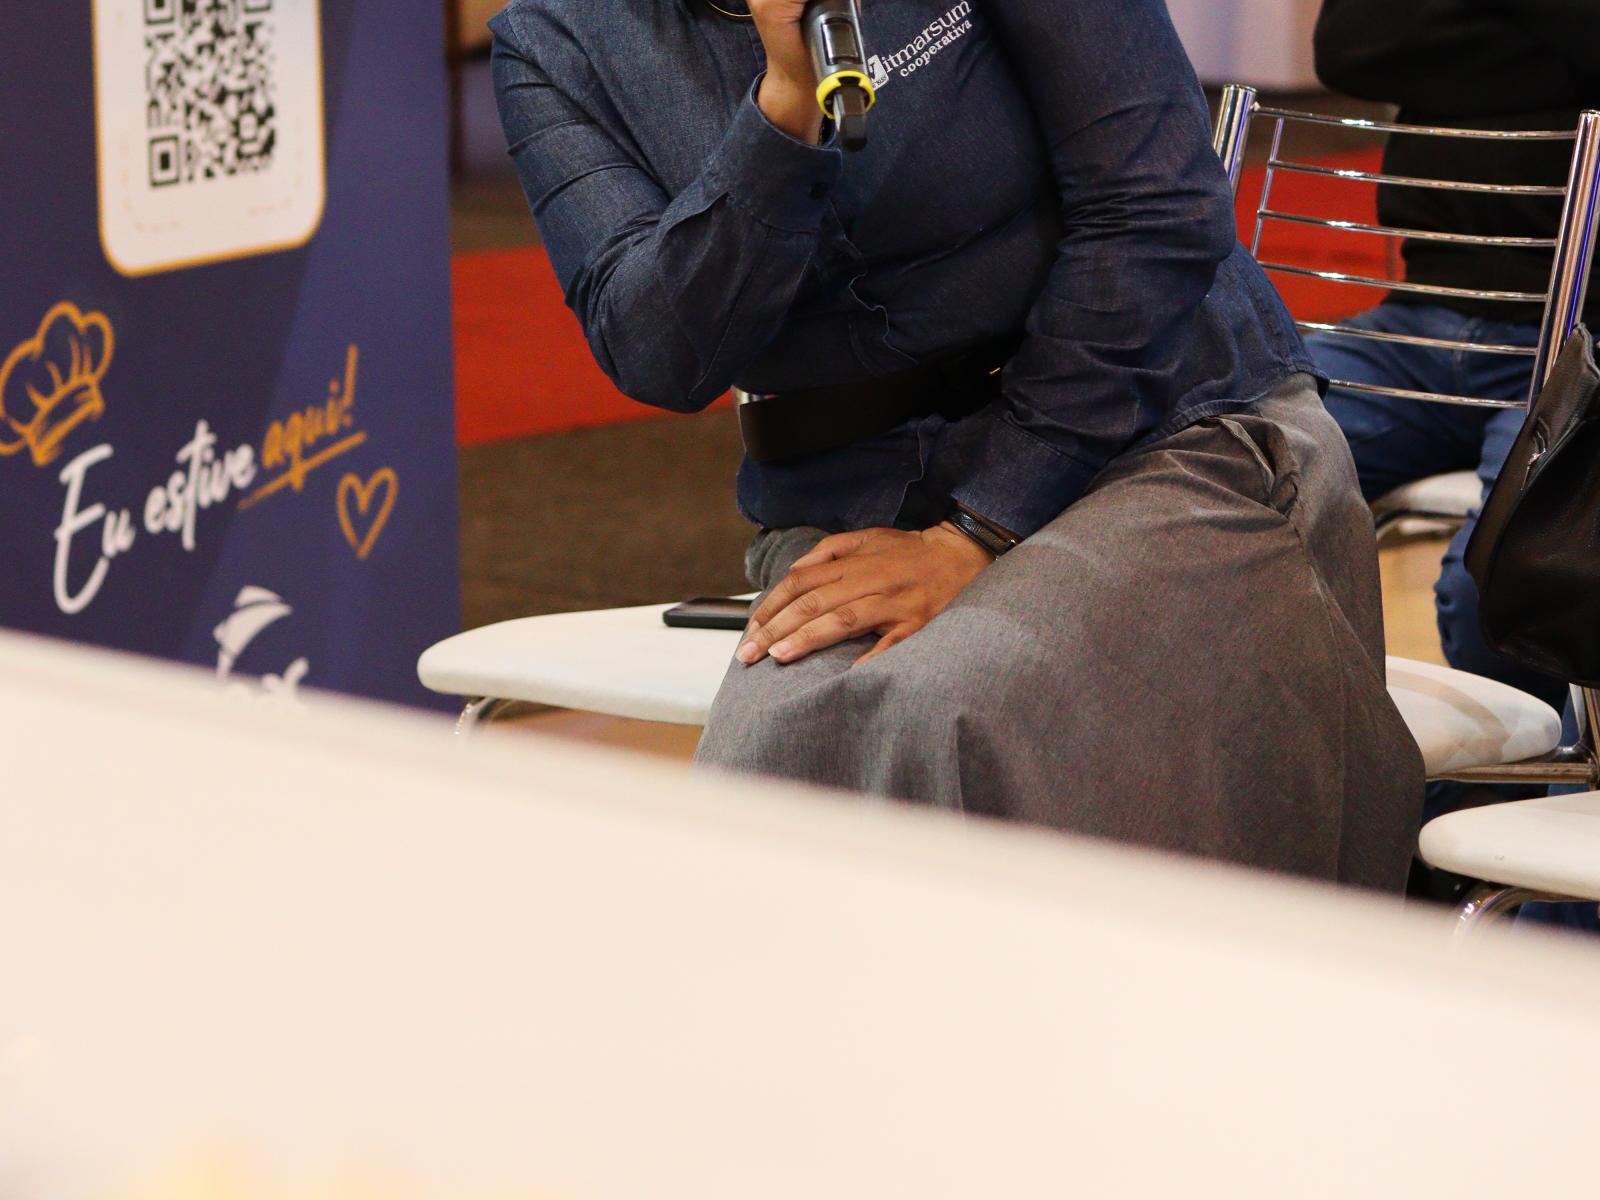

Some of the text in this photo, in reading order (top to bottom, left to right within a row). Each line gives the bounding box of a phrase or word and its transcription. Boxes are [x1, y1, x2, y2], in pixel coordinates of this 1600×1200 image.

[899, 19, 973, 78] cooperativa
[54, 343, 359, 614] Eu estive aqui!
